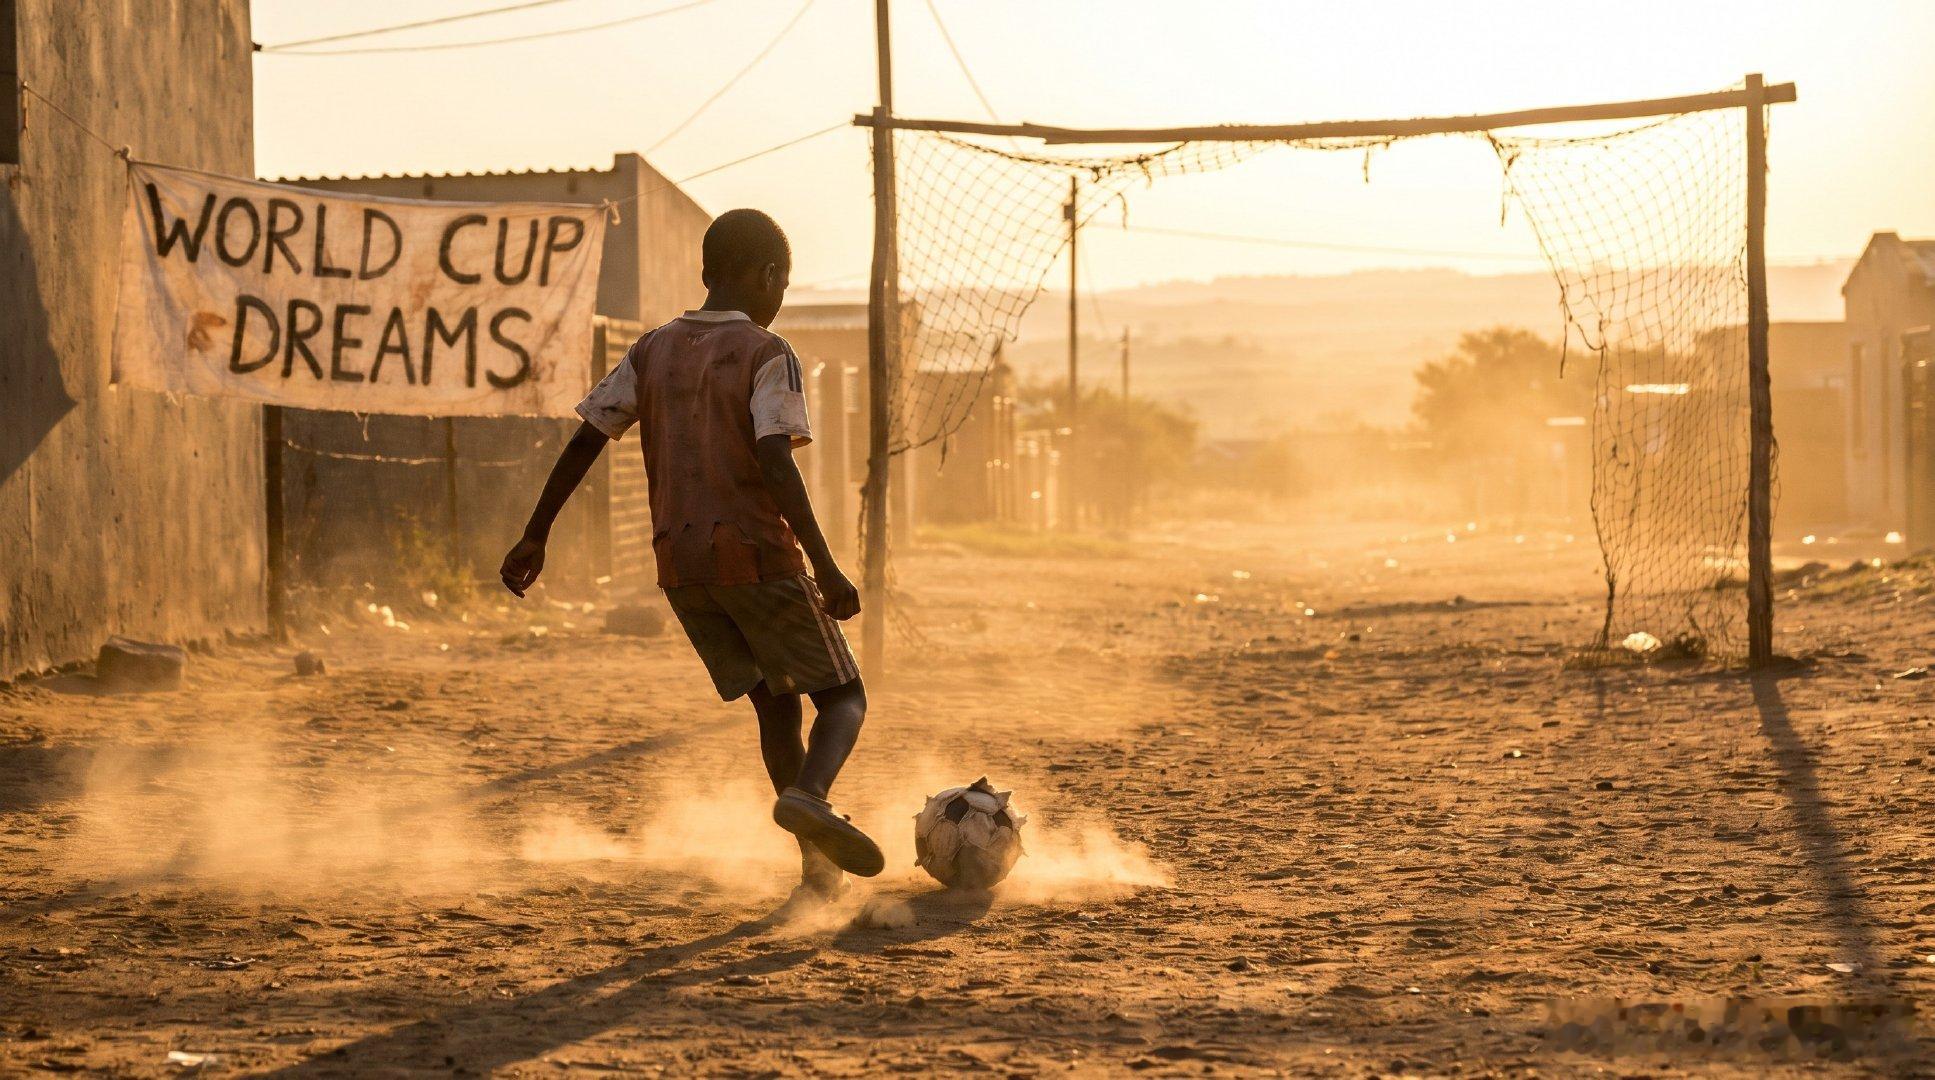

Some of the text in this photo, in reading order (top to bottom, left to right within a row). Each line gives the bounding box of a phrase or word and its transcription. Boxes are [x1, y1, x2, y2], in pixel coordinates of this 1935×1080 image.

[145, 182, 585, 287] WORLD CUP
[228, 294, 532, 389] DREAMS
